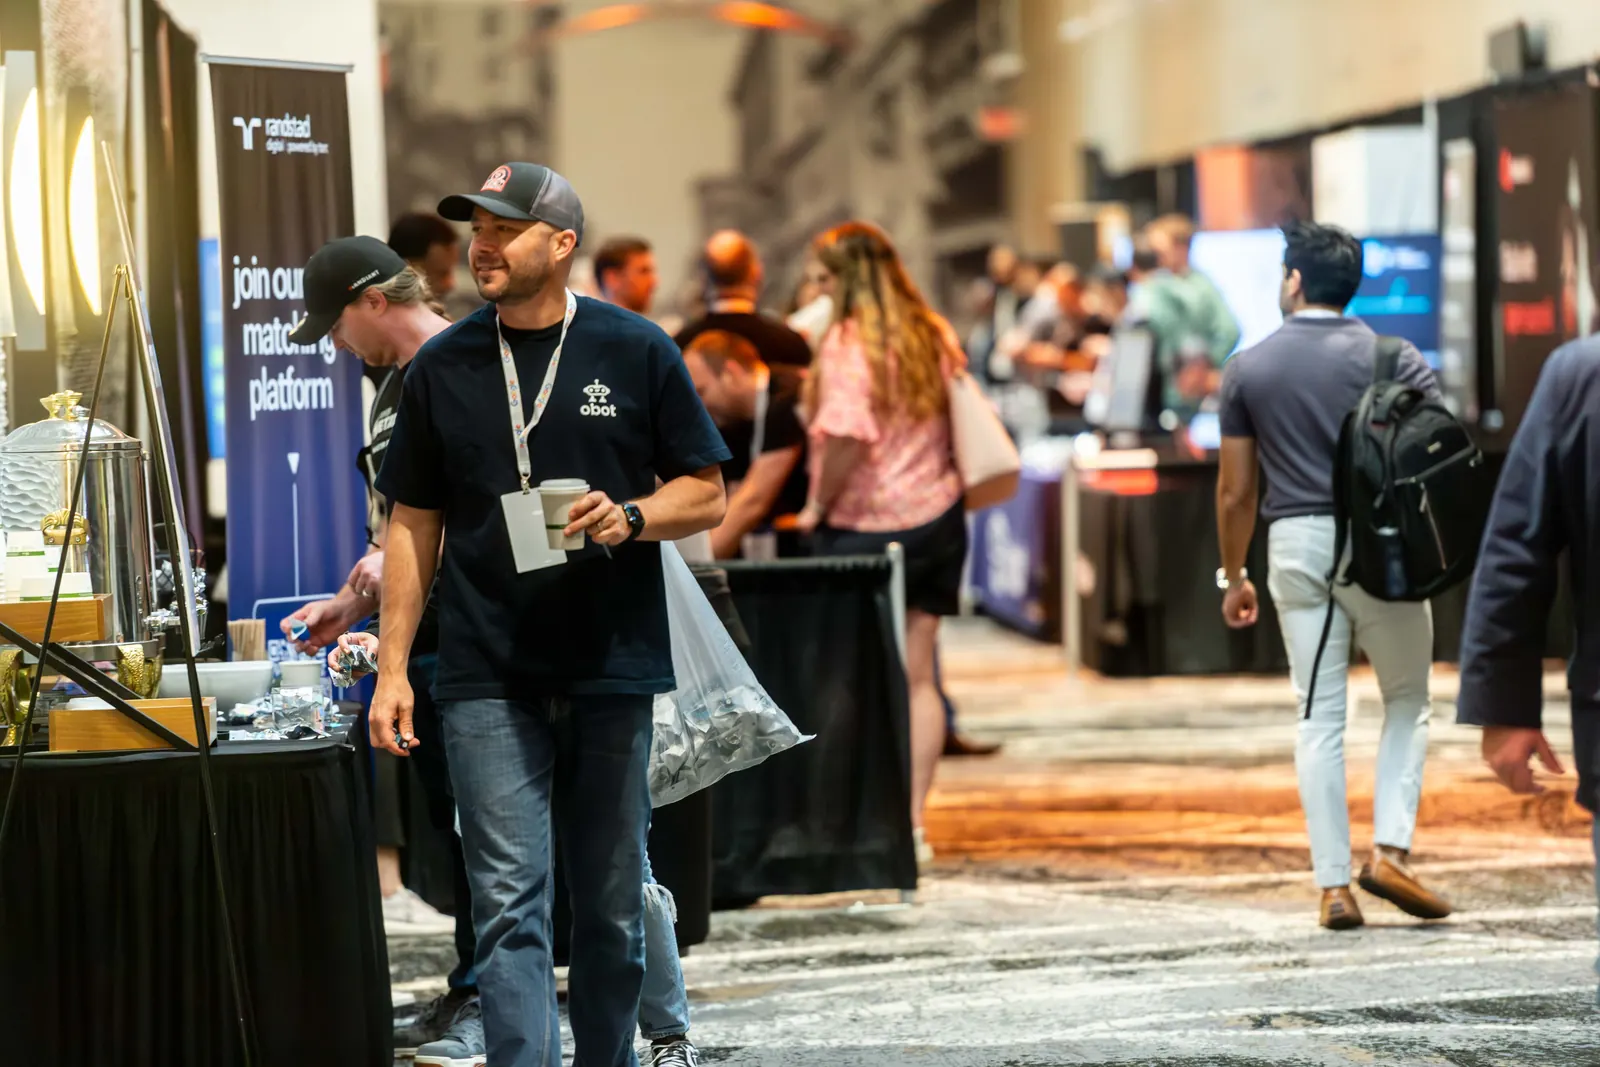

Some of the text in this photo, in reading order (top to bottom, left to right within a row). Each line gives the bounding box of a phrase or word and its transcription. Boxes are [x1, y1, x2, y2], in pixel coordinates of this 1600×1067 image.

[232, 255, 270, 310] join
[250, 365, 334, 421] platform
[580, 402, 617, 417] obot
